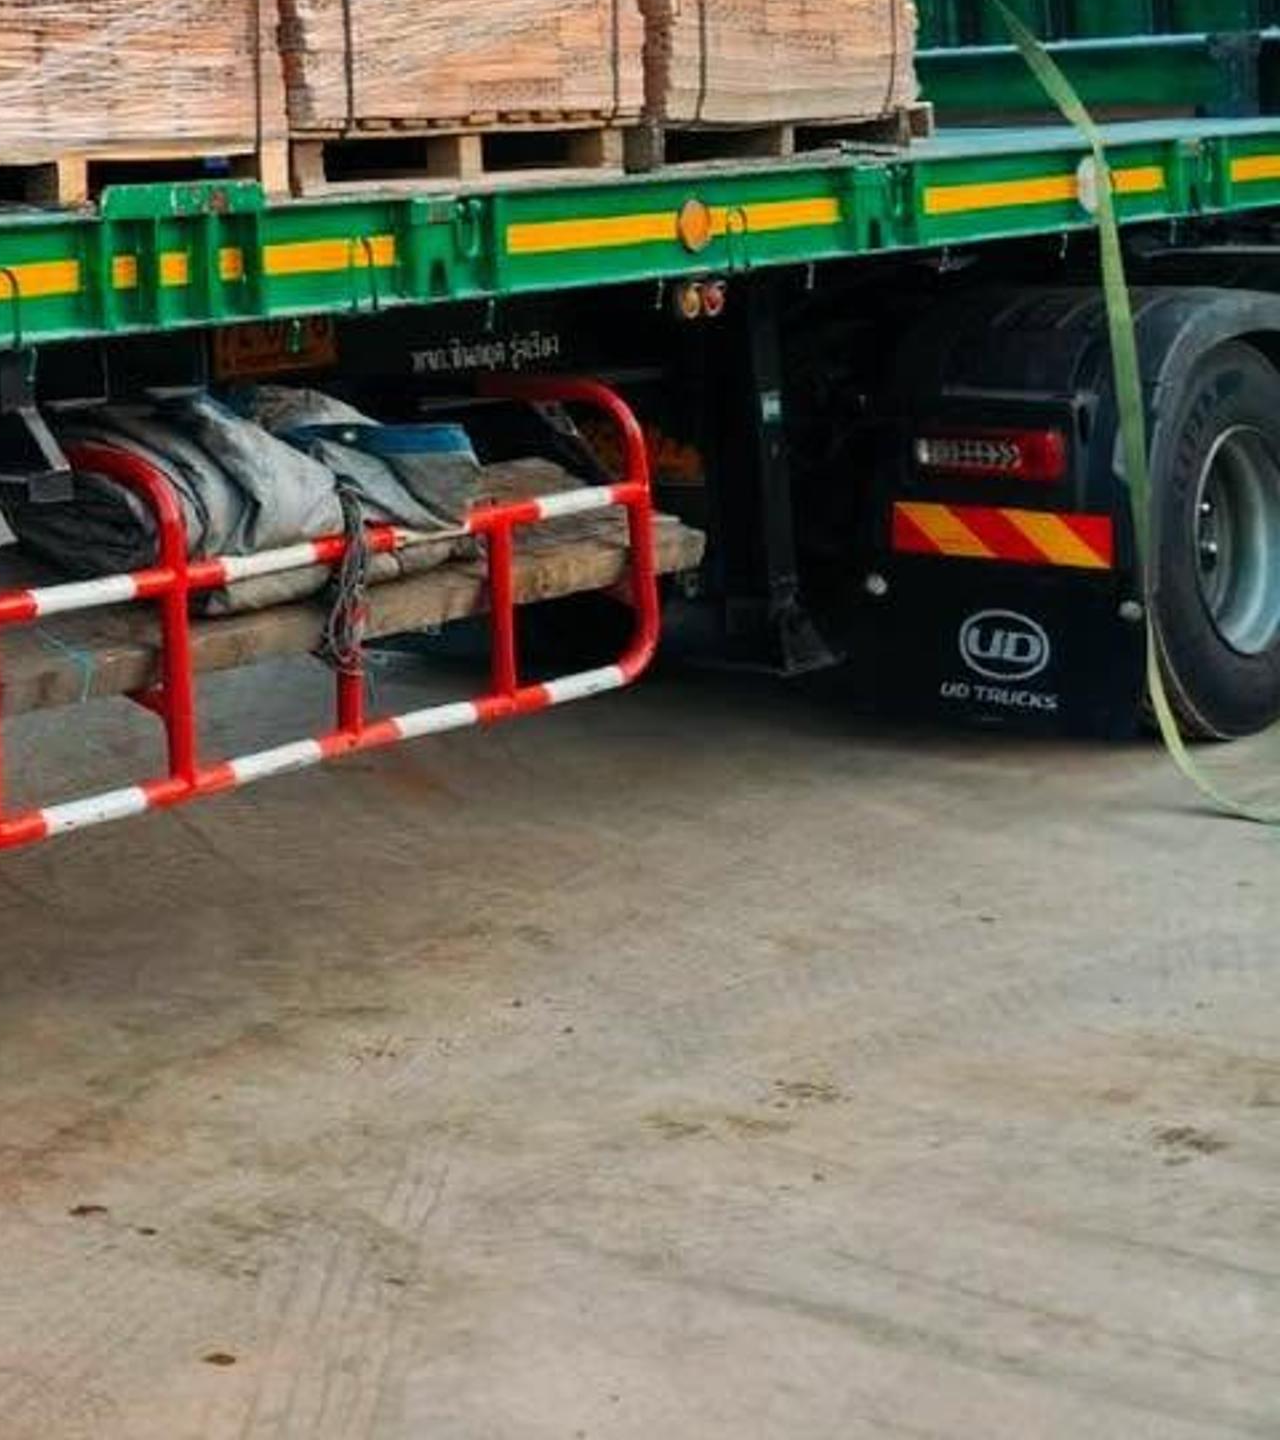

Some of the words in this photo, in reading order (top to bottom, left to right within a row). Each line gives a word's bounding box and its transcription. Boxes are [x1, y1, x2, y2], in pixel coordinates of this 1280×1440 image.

[966, 626, 1042, 663] UD
[939, 681, 970, 699] UD
[973, 683, 1060, 709] TRUCKS
